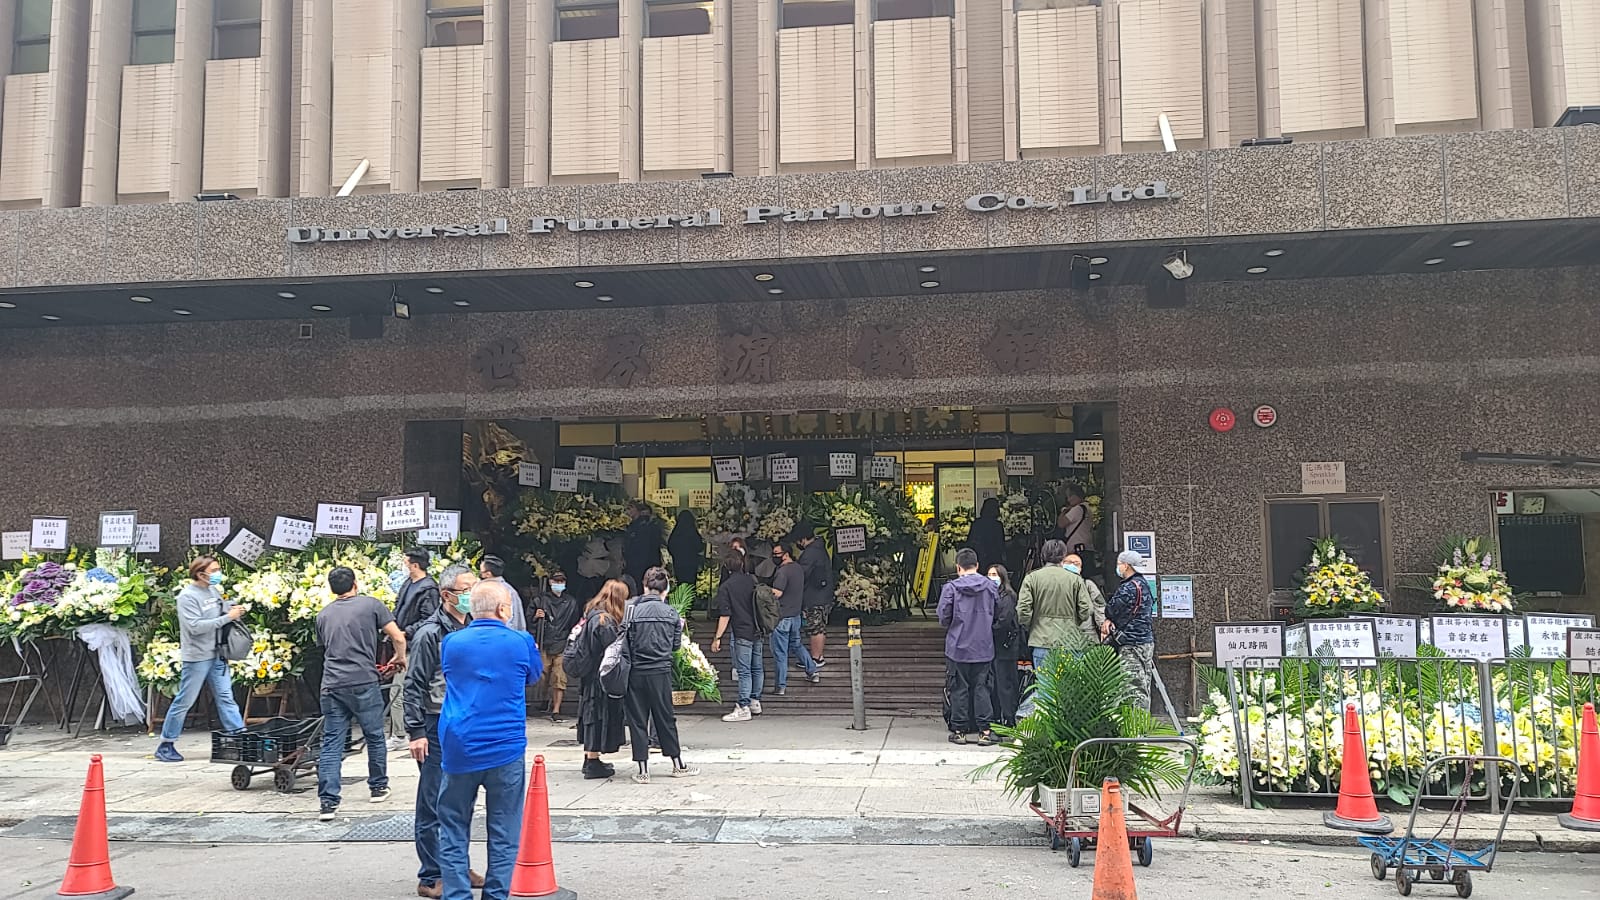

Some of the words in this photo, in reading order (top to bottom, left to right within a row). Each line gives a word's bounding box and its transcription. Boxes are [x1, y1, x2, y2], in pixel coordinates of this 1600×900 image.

[286, 217, 510, 244] Universal
[527, 207, 726, 236] Funeral
[742, 196, 946, 226] Parlour
[1448, 632, 1489, 642] 音容宛在
[1228, 640, 1268, 650] 仙凡路隔
